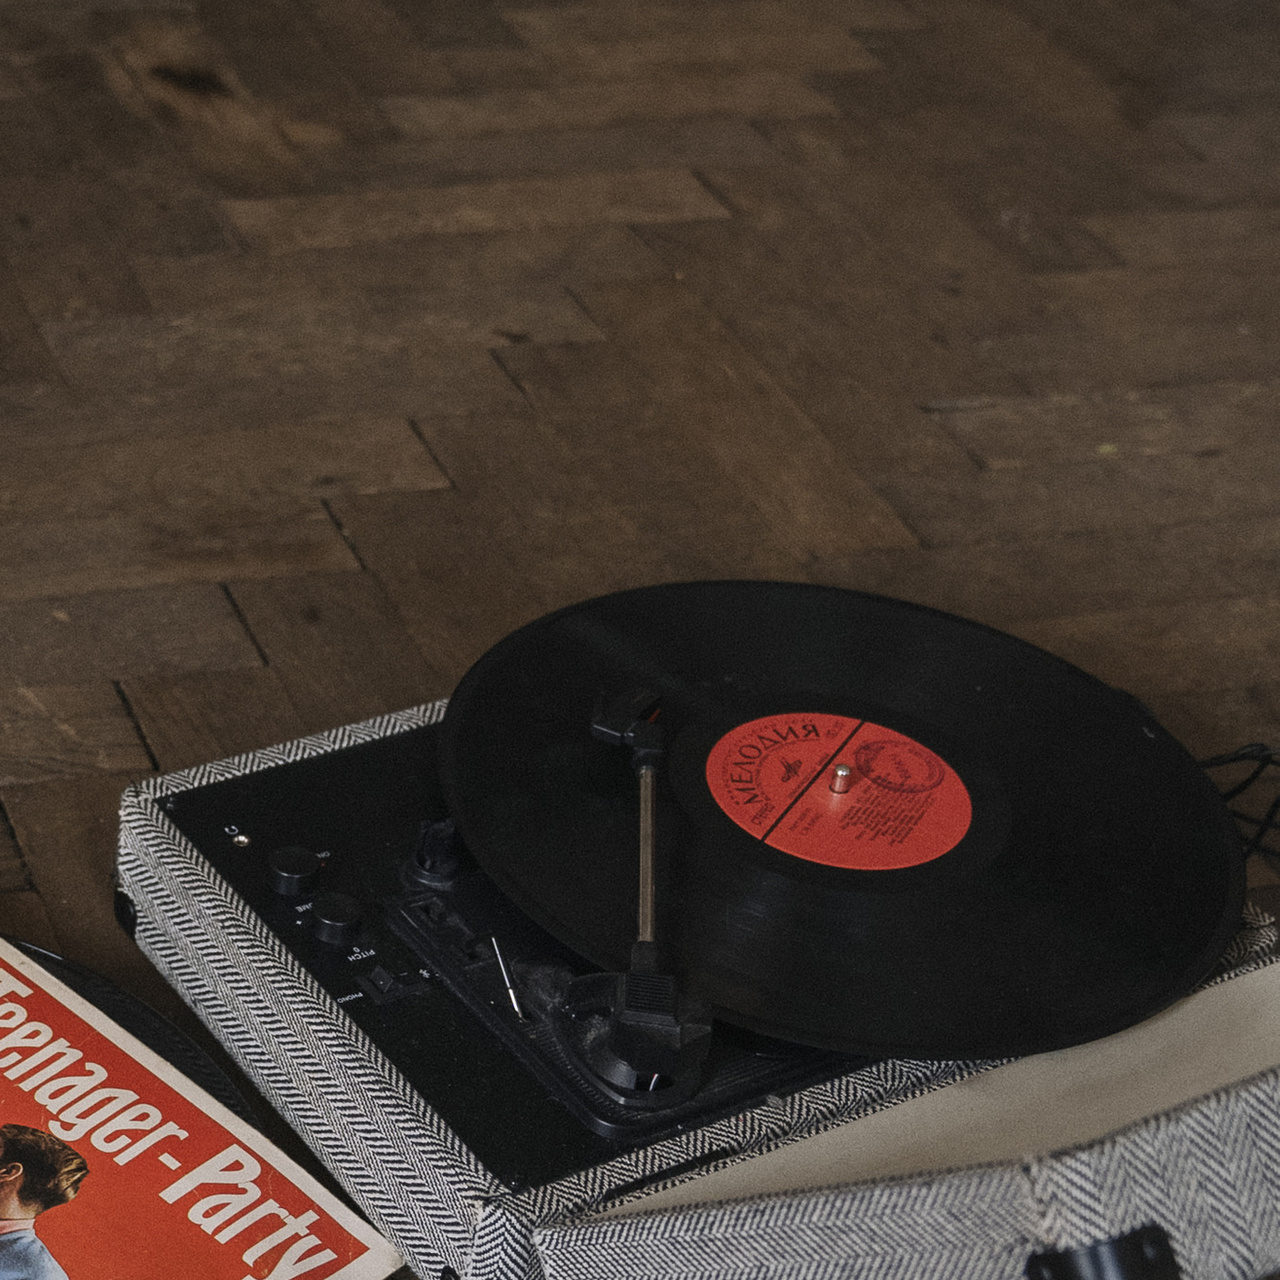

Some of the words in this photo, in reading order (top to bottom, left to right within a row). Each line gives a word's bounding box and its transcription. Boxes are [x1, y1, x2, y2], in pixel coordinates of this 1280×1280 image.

[730, 724, 820, 805] МЕЛОДИЯ
[347, 948, 376, 962] PITCH
[336, 991, 364, 1004] PHONO
